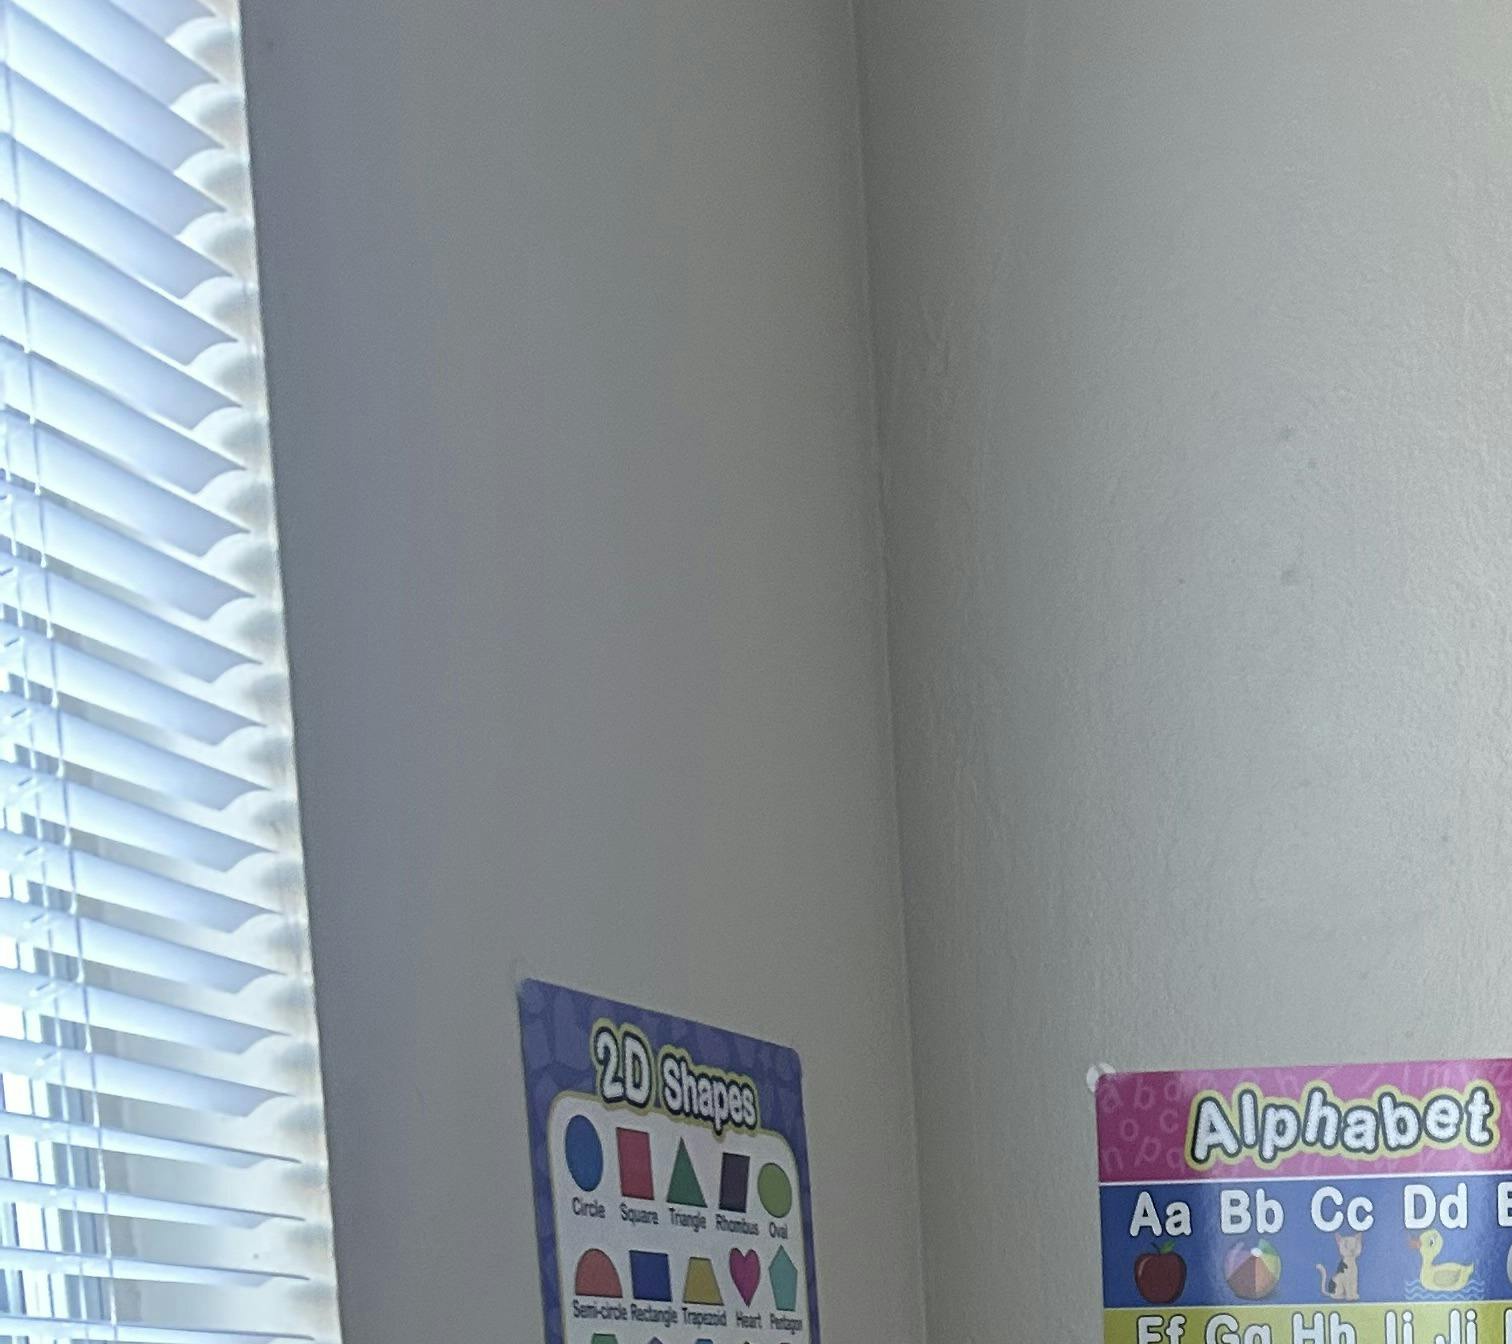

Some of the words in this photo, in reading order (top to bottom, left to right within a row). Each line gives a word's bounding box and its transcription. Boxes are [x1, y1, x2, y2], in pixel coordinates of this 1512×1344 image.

[596, 1028, 654, 1108] 2D
[660, 1053, 758, 1134] Shapes
[1191, 1086, 1494, 1164] Alphabet
[572, 1196, 605, 1219] Circle
[619, 1202, 659, 1226] Square
[668, 1206, 706, 1232] Triangle
[715, 1213, 759, 1236] Rhombus
[768, 1221, 788, 1239] Oval
[1129, 1191, 1193, 1238] Aa
[1219, 1187, 1285, 1235] Bb
[1310, 1185, 1375, 1233] Cc
[1403, 1182, 1468, 1230] Dd
[573, 1299, 627, 1321] Semi-circle
[630, 1303, 678, 1328] Rectangle
[682, 1307, 727, 1330] Trapezoid
[736, 1311, 763, 1329] Heart
[770, 1312, 802, 1335] Pentagon
